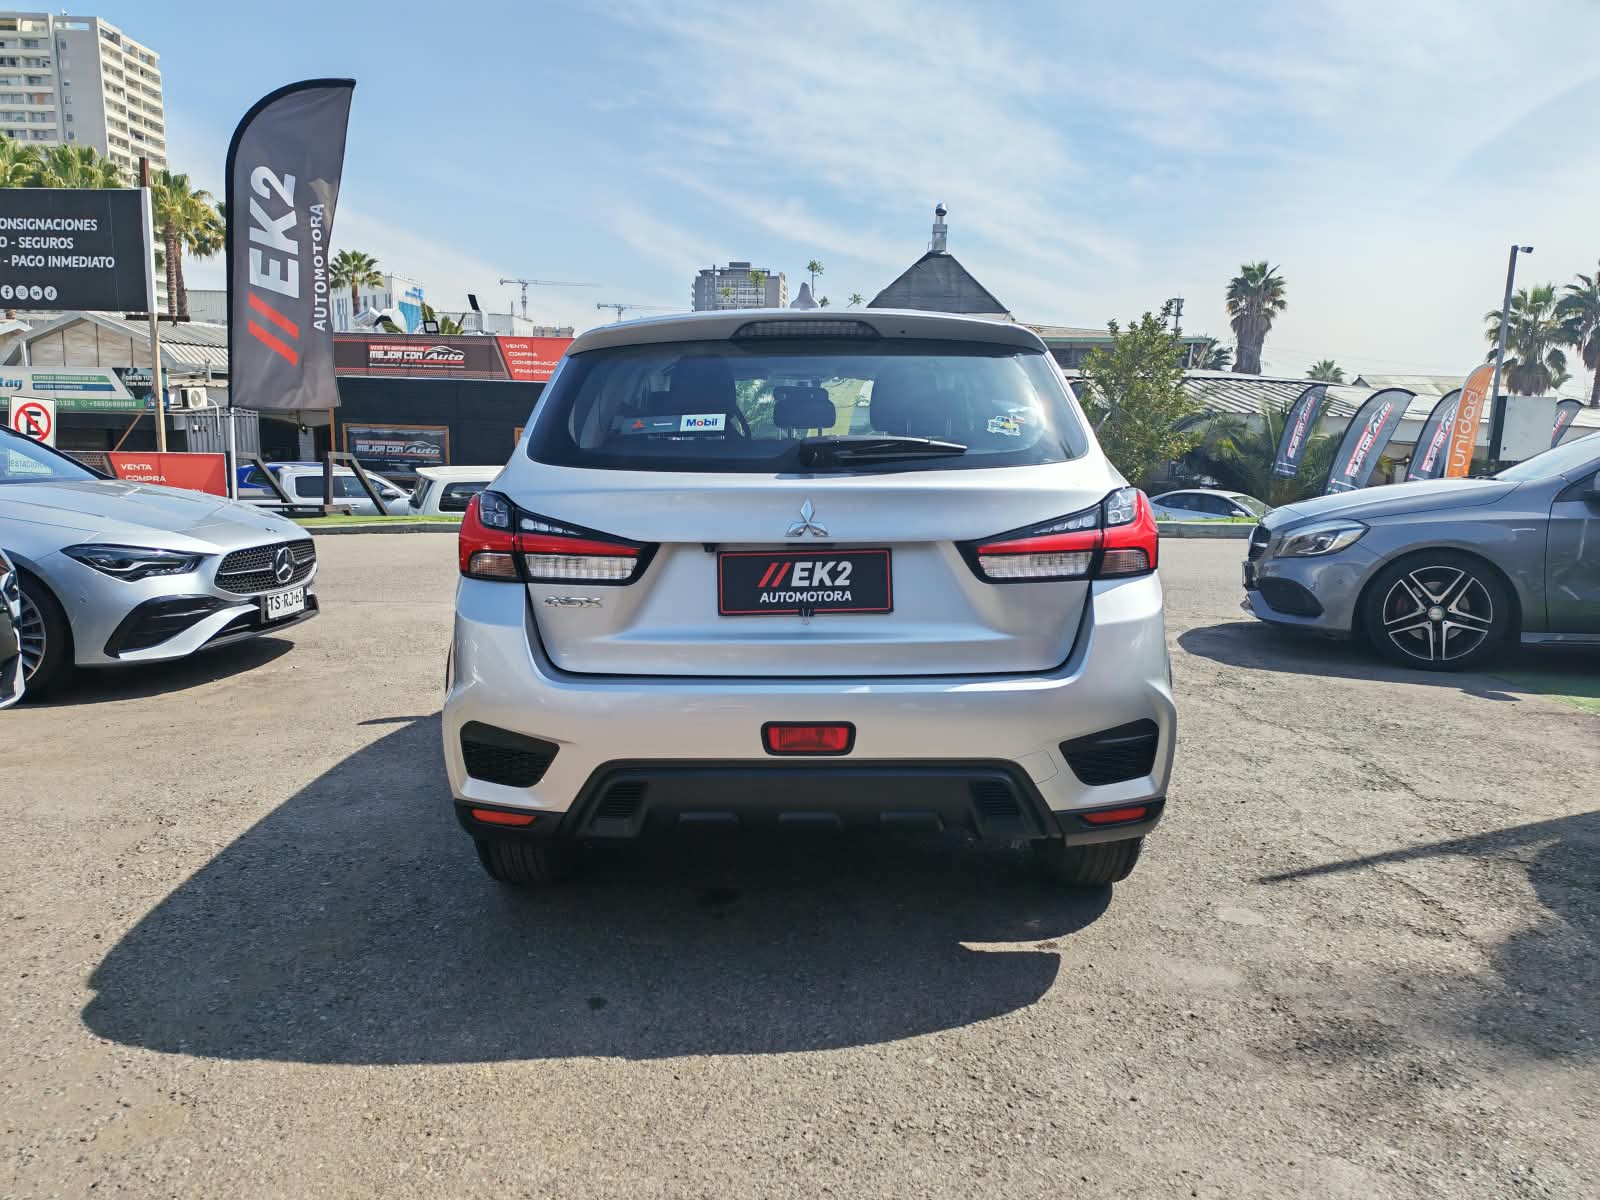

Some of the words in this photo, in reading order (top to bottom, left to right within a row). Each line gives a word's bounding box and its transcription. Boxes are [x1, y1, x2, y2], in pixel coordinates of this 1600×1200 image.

[0, 217, 98, 232] ONSIGNACIONES
[18, 236, 74, 249] SEGUROS
[11, 254, 45, 267] PAGO
[48, 255, 115, 268] INMEDIATO
[309, 203, 327, 332] AUTOMOTORA
[369, 350, 402, 359] MEJOR
[404, 351, 423, 359] CON
[686, 418, 718, 427] Mobil
[1453, 390, 1479, 467] unidad
[120, 463, 152, 471] VENTA
[125, 474, 167, 482] COMPRA
[760, 590, 852, 603] AUTOMOTORA
